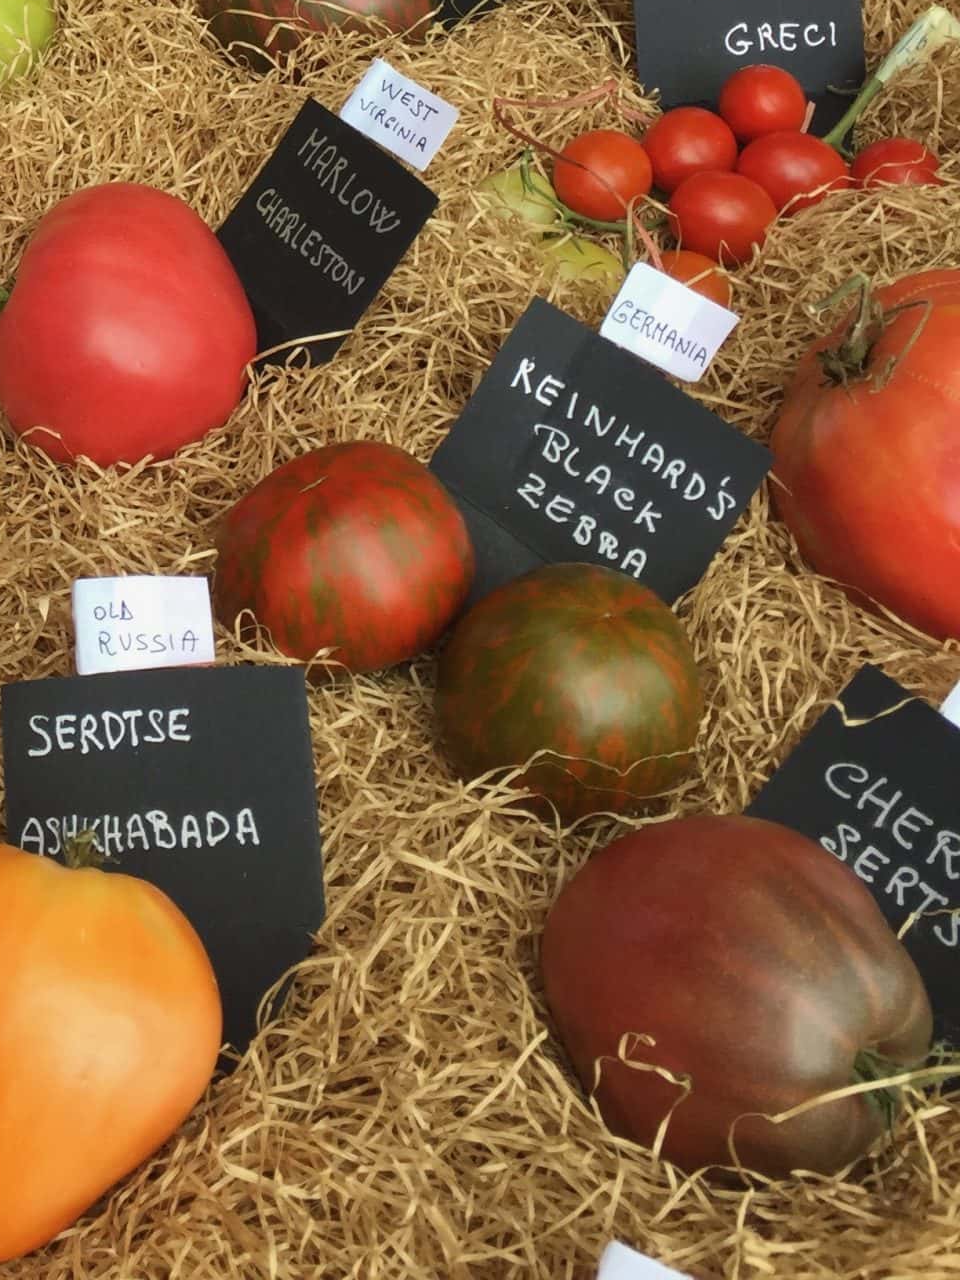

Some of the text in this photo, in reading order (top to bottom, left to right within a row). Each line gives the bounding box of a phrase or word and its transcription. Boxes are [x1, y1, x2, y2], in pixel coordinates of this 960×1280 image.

[725, 21, 839, 55] GRECI
[360, 98, 427, 152] VIRGINIA
[381, 79, 439, 120] WEST
[297, 127, 401, 234] MARLOW
[256, 188, 365, 296] CHARLESTON
[611, 300, 708, 367] GERMANIA
[534, 423, 662, 533] BLACK
[517, 473, 648, 578] ZEBRA
[93, 600, 134, 621] OLD
[98, 630, 199, 656] RUSSIA
[28, 708, 191, 757] SERDTSE
